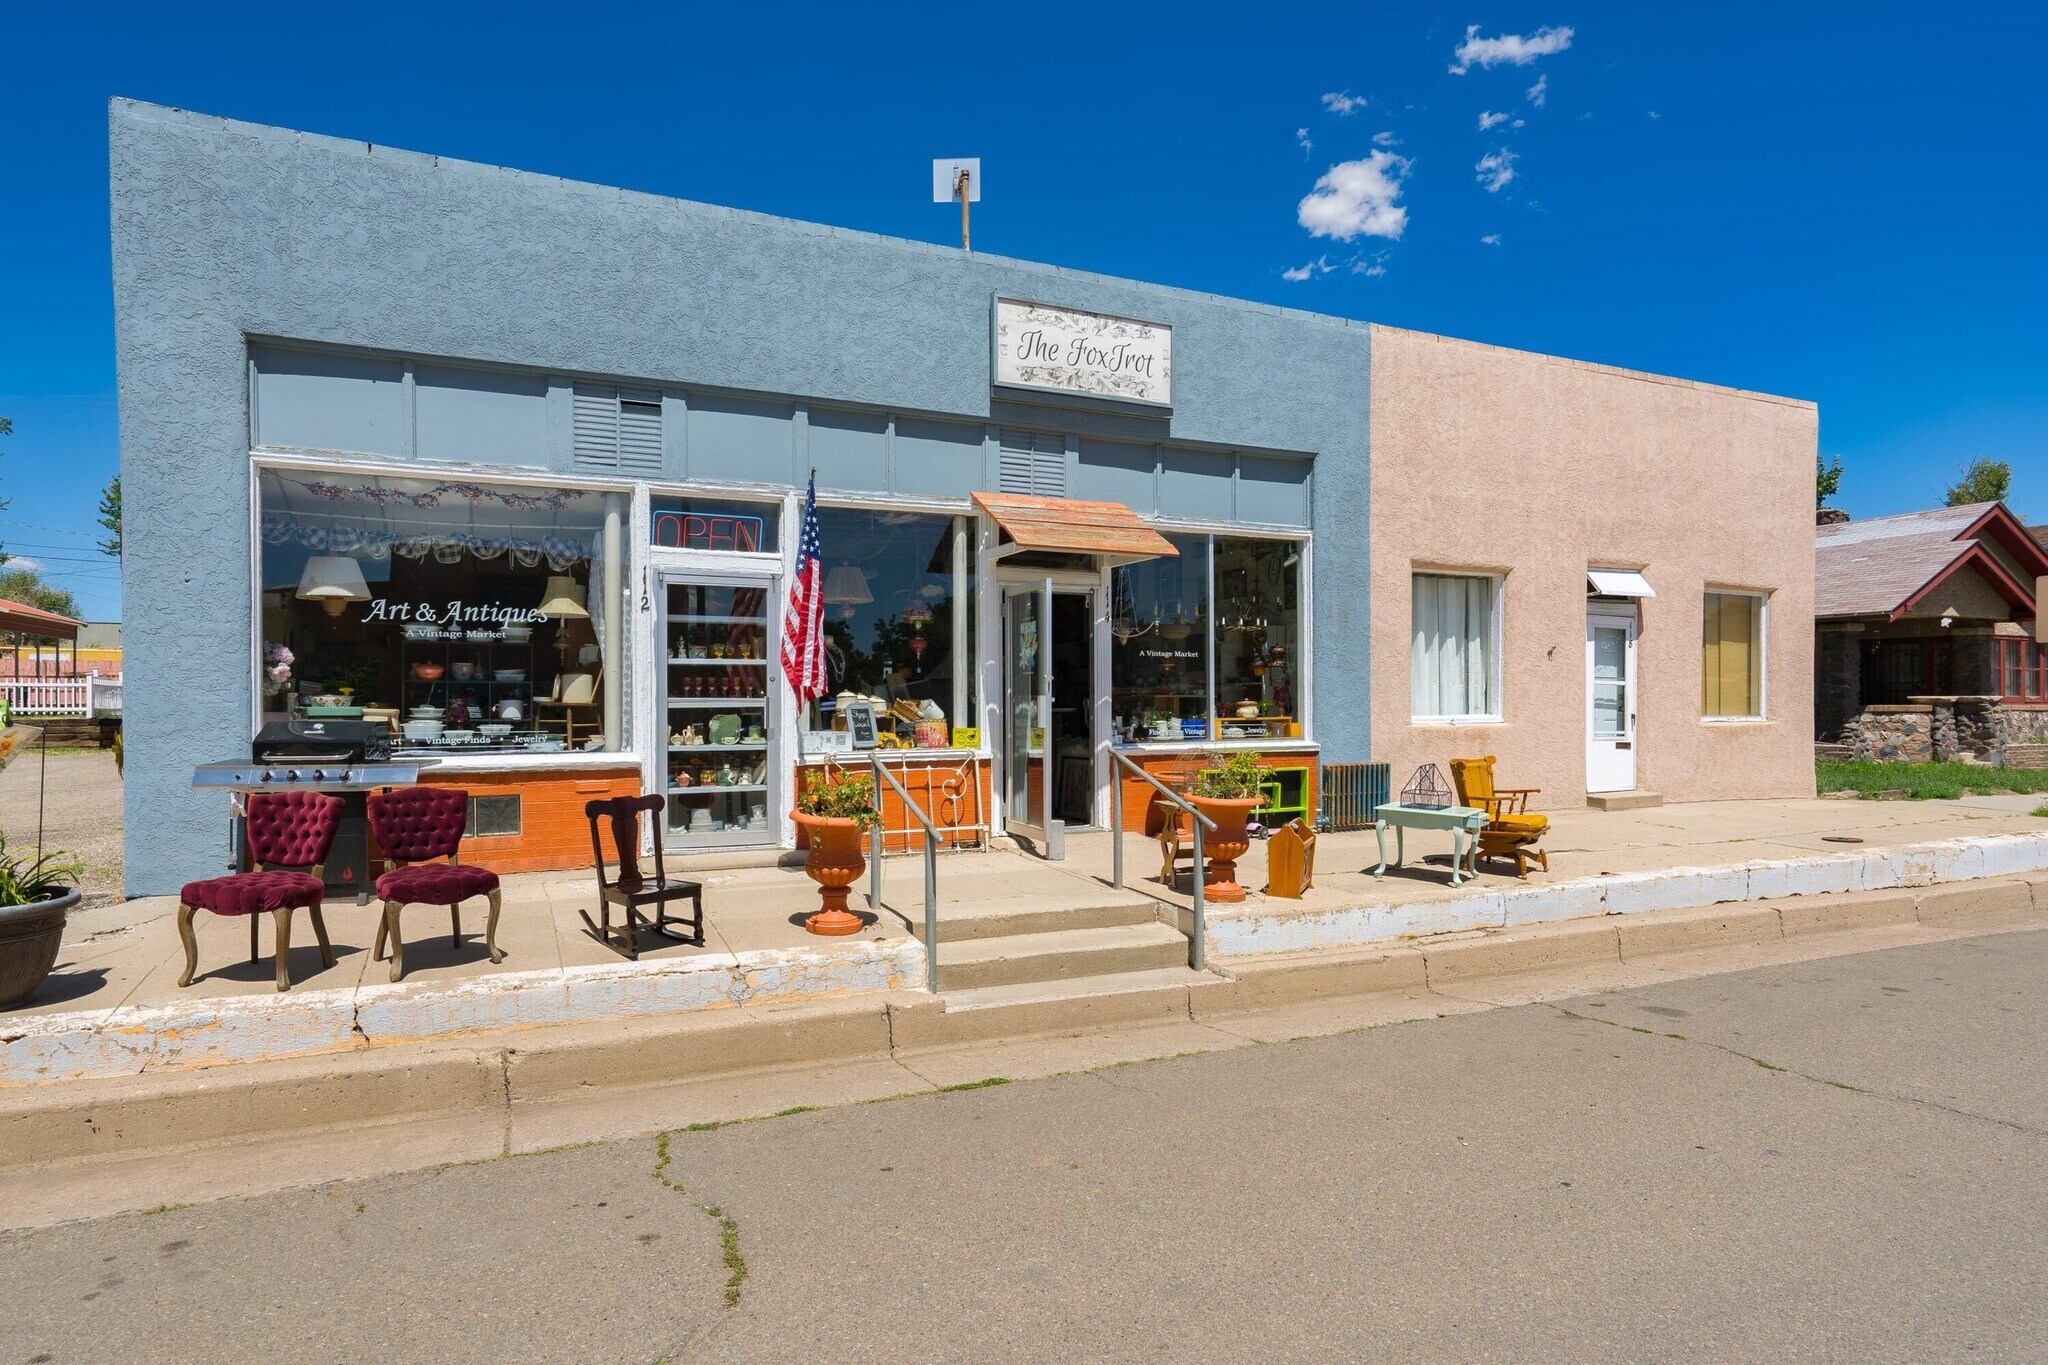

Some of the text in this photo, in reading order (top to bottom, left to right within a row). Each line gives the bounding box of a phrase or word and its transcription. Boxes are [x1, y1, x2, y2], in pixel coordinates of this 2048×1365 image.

[1017, 330, 1059, 362] The
[657, 515, 758, 552] OPEN
[640, 565, 650, 614] 112
[361, 598, 549, 630] Art & Antiques
[406, 629, 508, 640] A Vintage Market
[1146, 650, 1173, 659] Vintage
[1174, 650, 1199, 658] Market
[390, 734, 548, 747] rt Vintage Finds Jewelry
